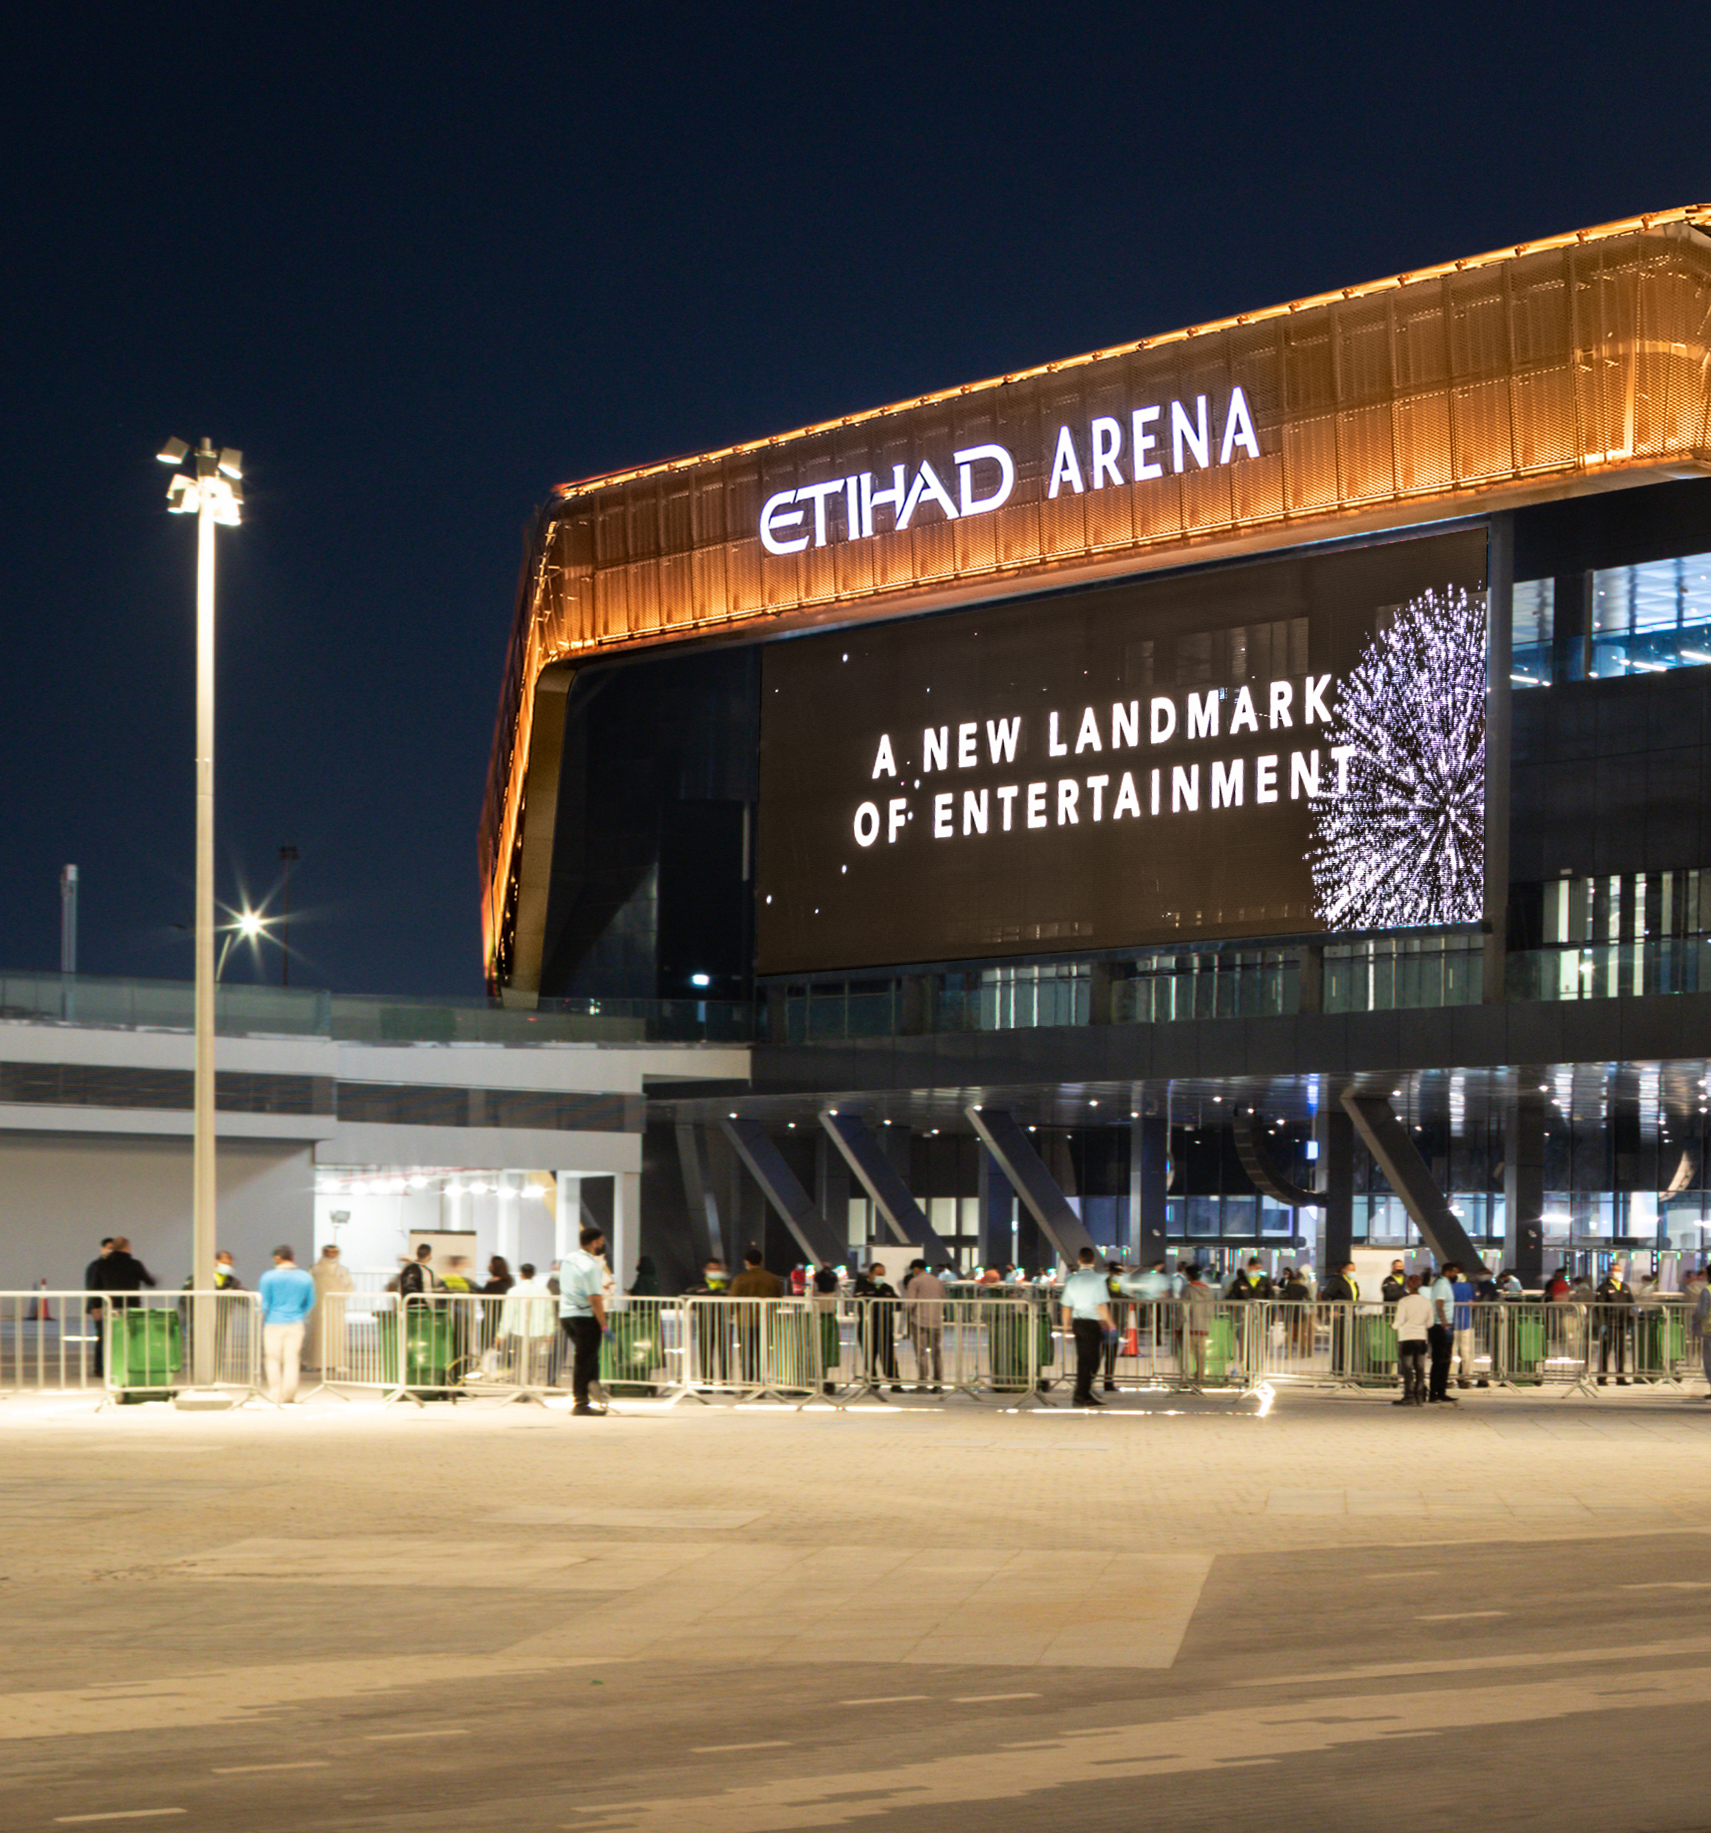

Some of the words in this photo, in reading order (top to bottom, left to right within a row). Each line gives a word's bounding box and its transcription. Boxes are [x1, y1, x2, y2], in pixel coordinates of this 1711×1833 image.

[759, 444, 1014, 555] ETIHAD
[1048, 387, 1261, 499] ARENA
[871, 733, 897, 780] A
[923, 716, 1022, 773] NEW
[1048, 673, 1334, 757] LANDMARK
[853, 797, 909, 848] OF
[934, 745, 1356, 839] ENTERTAINMENT
